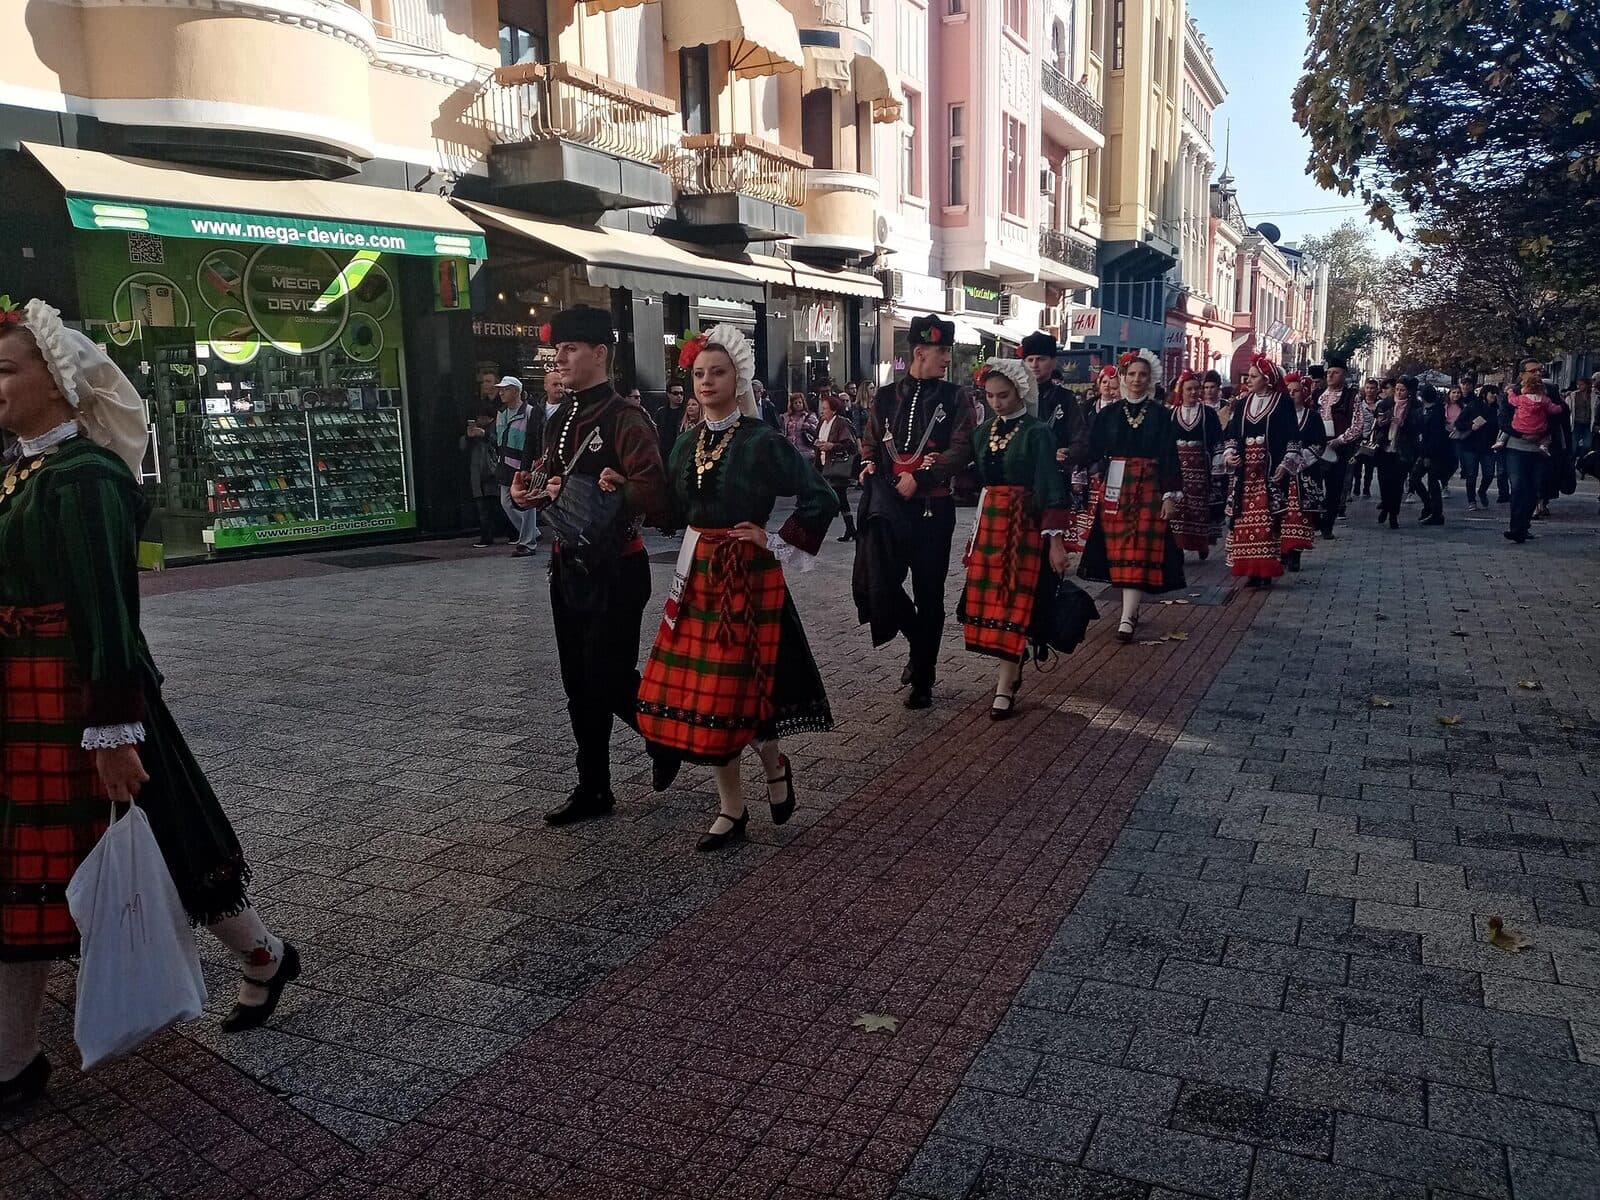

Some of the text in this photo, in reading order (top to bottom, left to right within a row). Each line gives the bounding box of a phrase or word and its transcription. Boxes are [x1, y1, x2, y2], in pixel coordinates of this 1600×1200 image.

[191, 219, 406, 249] www.mega-device.com
[271, 276, 320, 290] MEGA
[268, 298, 327, 312] DEVICE
[484, 322, 519, 337] FETISH
[256, 517, 396, 539] www.mega-device.com
